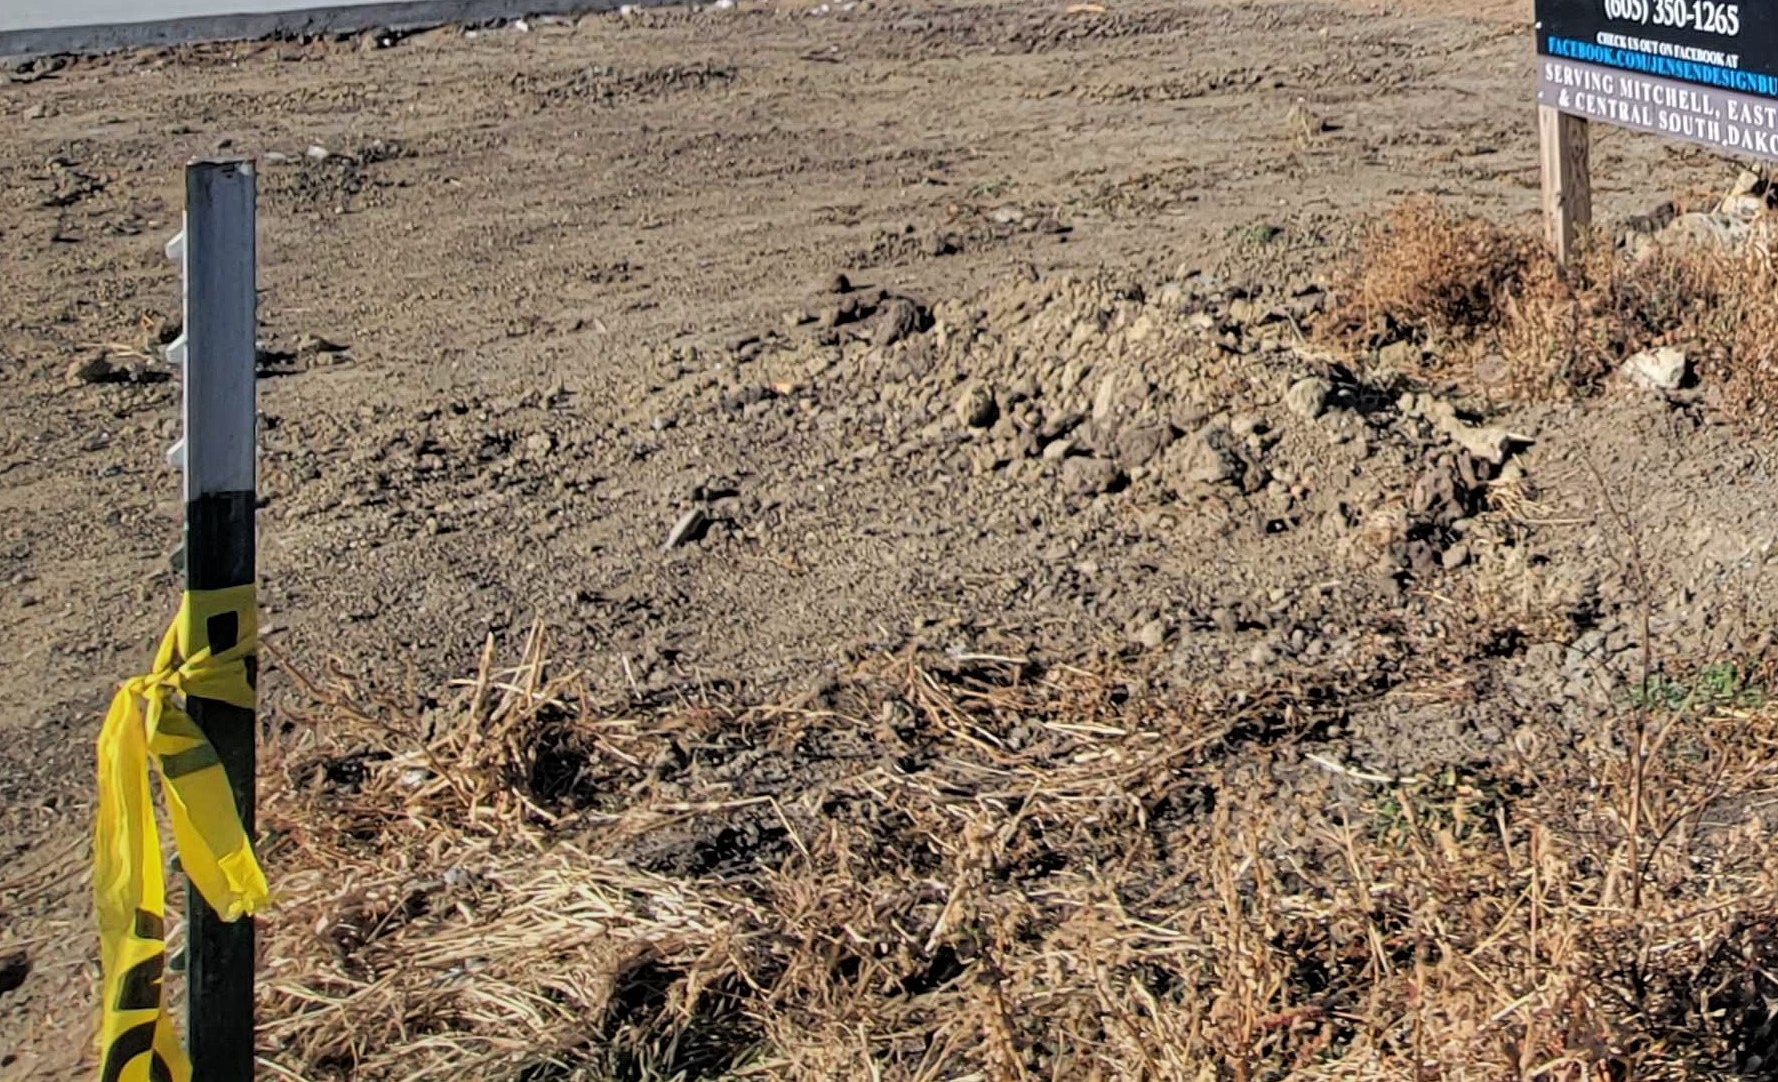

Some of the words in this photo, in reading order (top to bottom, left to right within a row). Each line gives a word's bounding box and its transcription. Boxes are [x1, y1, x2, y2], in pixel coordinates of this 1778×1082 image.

[1726, 54, 1739, 69] AT
[1545, 63, 1613, 94] SERVING
[1620, 77, 1721, 120] MITCHELL,
[1558, 88, 1570, 107] &
[1575, 92, 1652, 125] CENTRAL
[1659, 110, 1720, 141] SOUTH
